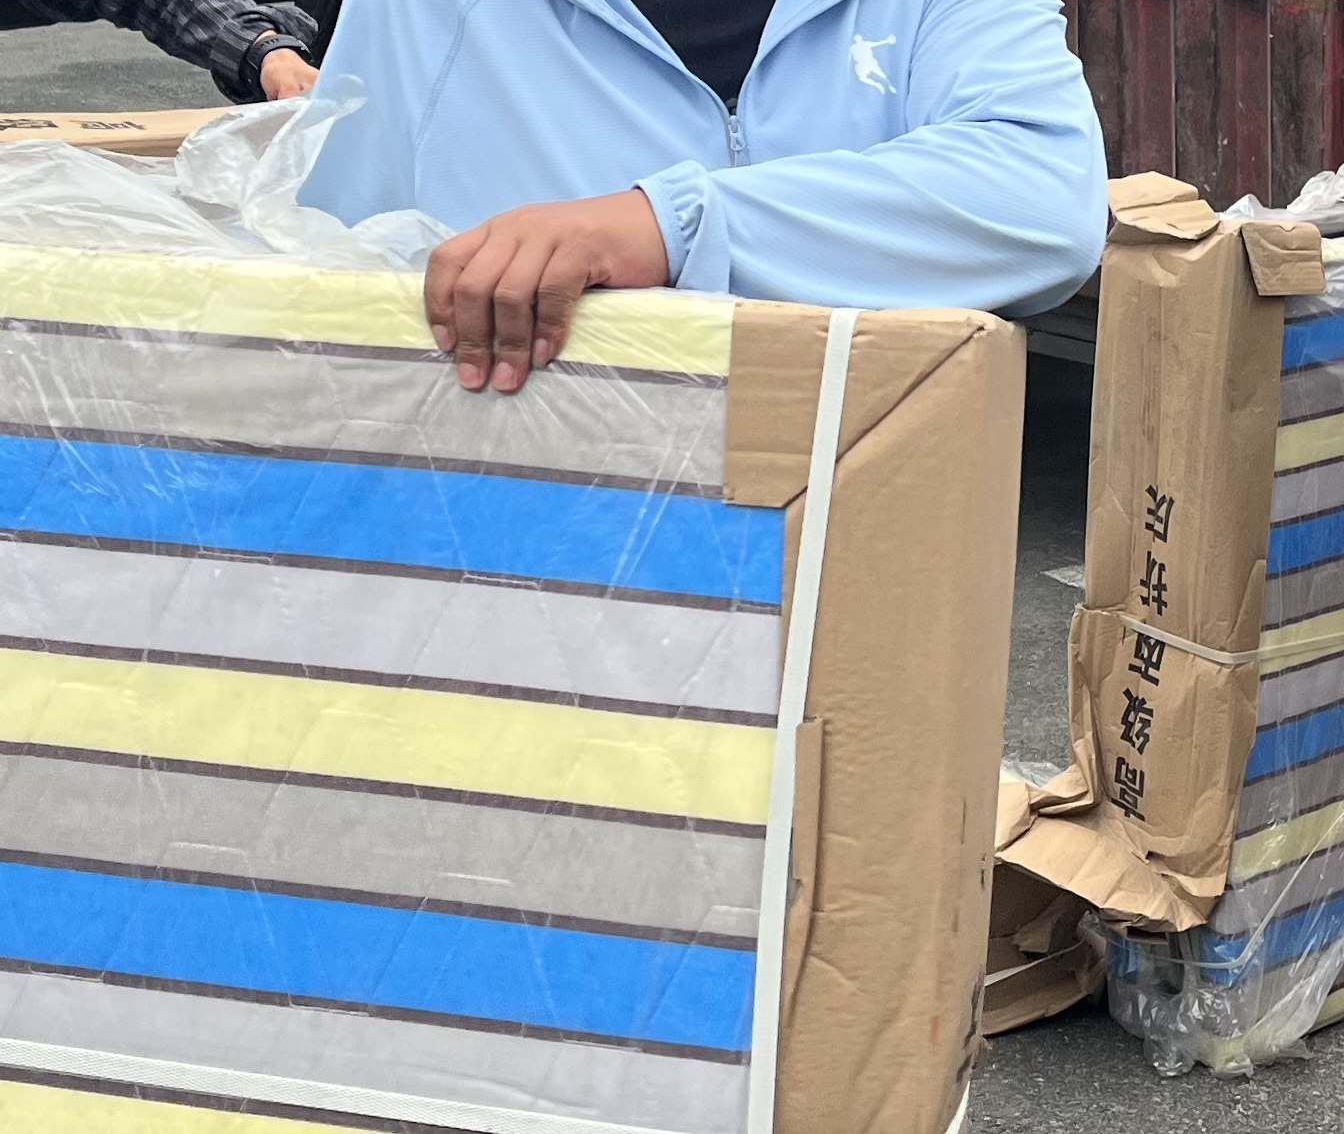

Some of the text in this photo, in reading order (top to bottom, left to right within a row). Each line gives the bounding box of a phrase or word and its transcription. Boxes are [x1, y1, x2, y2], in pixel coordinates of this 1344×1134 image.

[1111, 484, 1175, 822] 高级两折床
